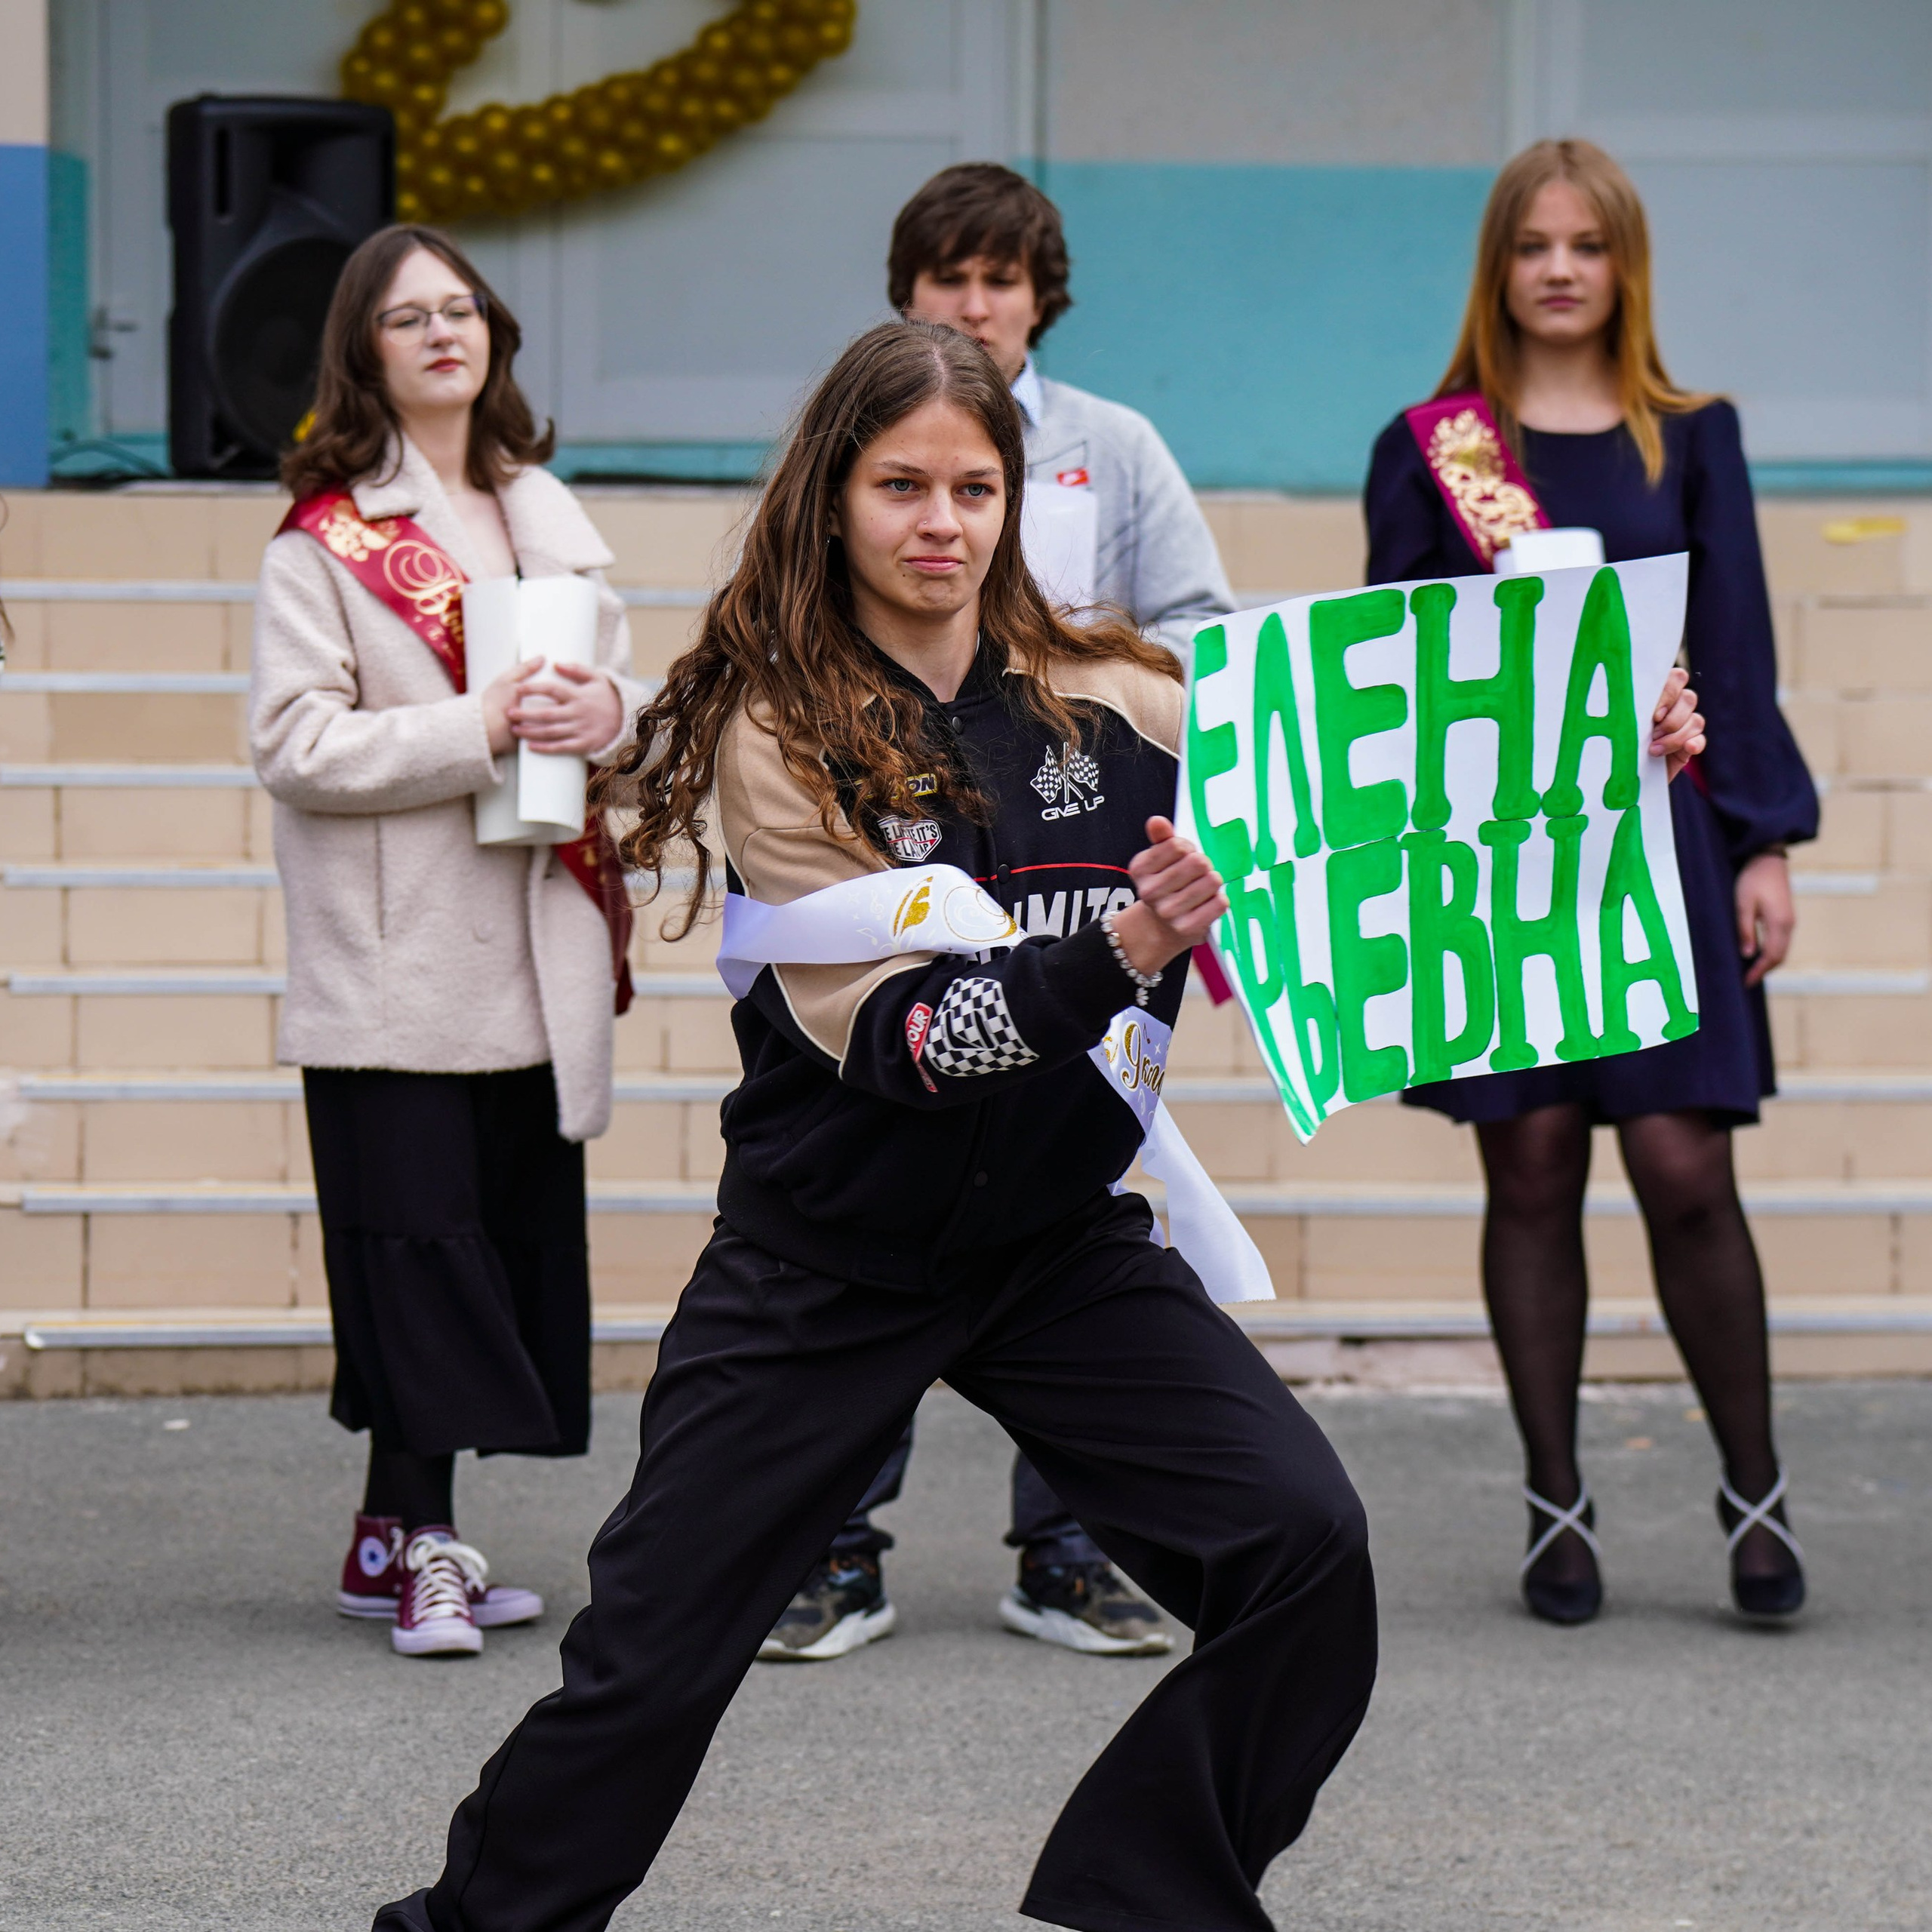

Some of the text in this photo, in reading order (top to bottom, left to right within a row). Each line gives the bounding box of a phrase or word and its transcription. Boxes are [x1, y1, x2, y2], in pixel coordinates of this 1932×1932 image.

[1189, 566, 1641, 884] ЕЛЕНА
[1041, 795, 1105, 821] GIVE UP
[1013, 886, 1135, 940] IMIT
